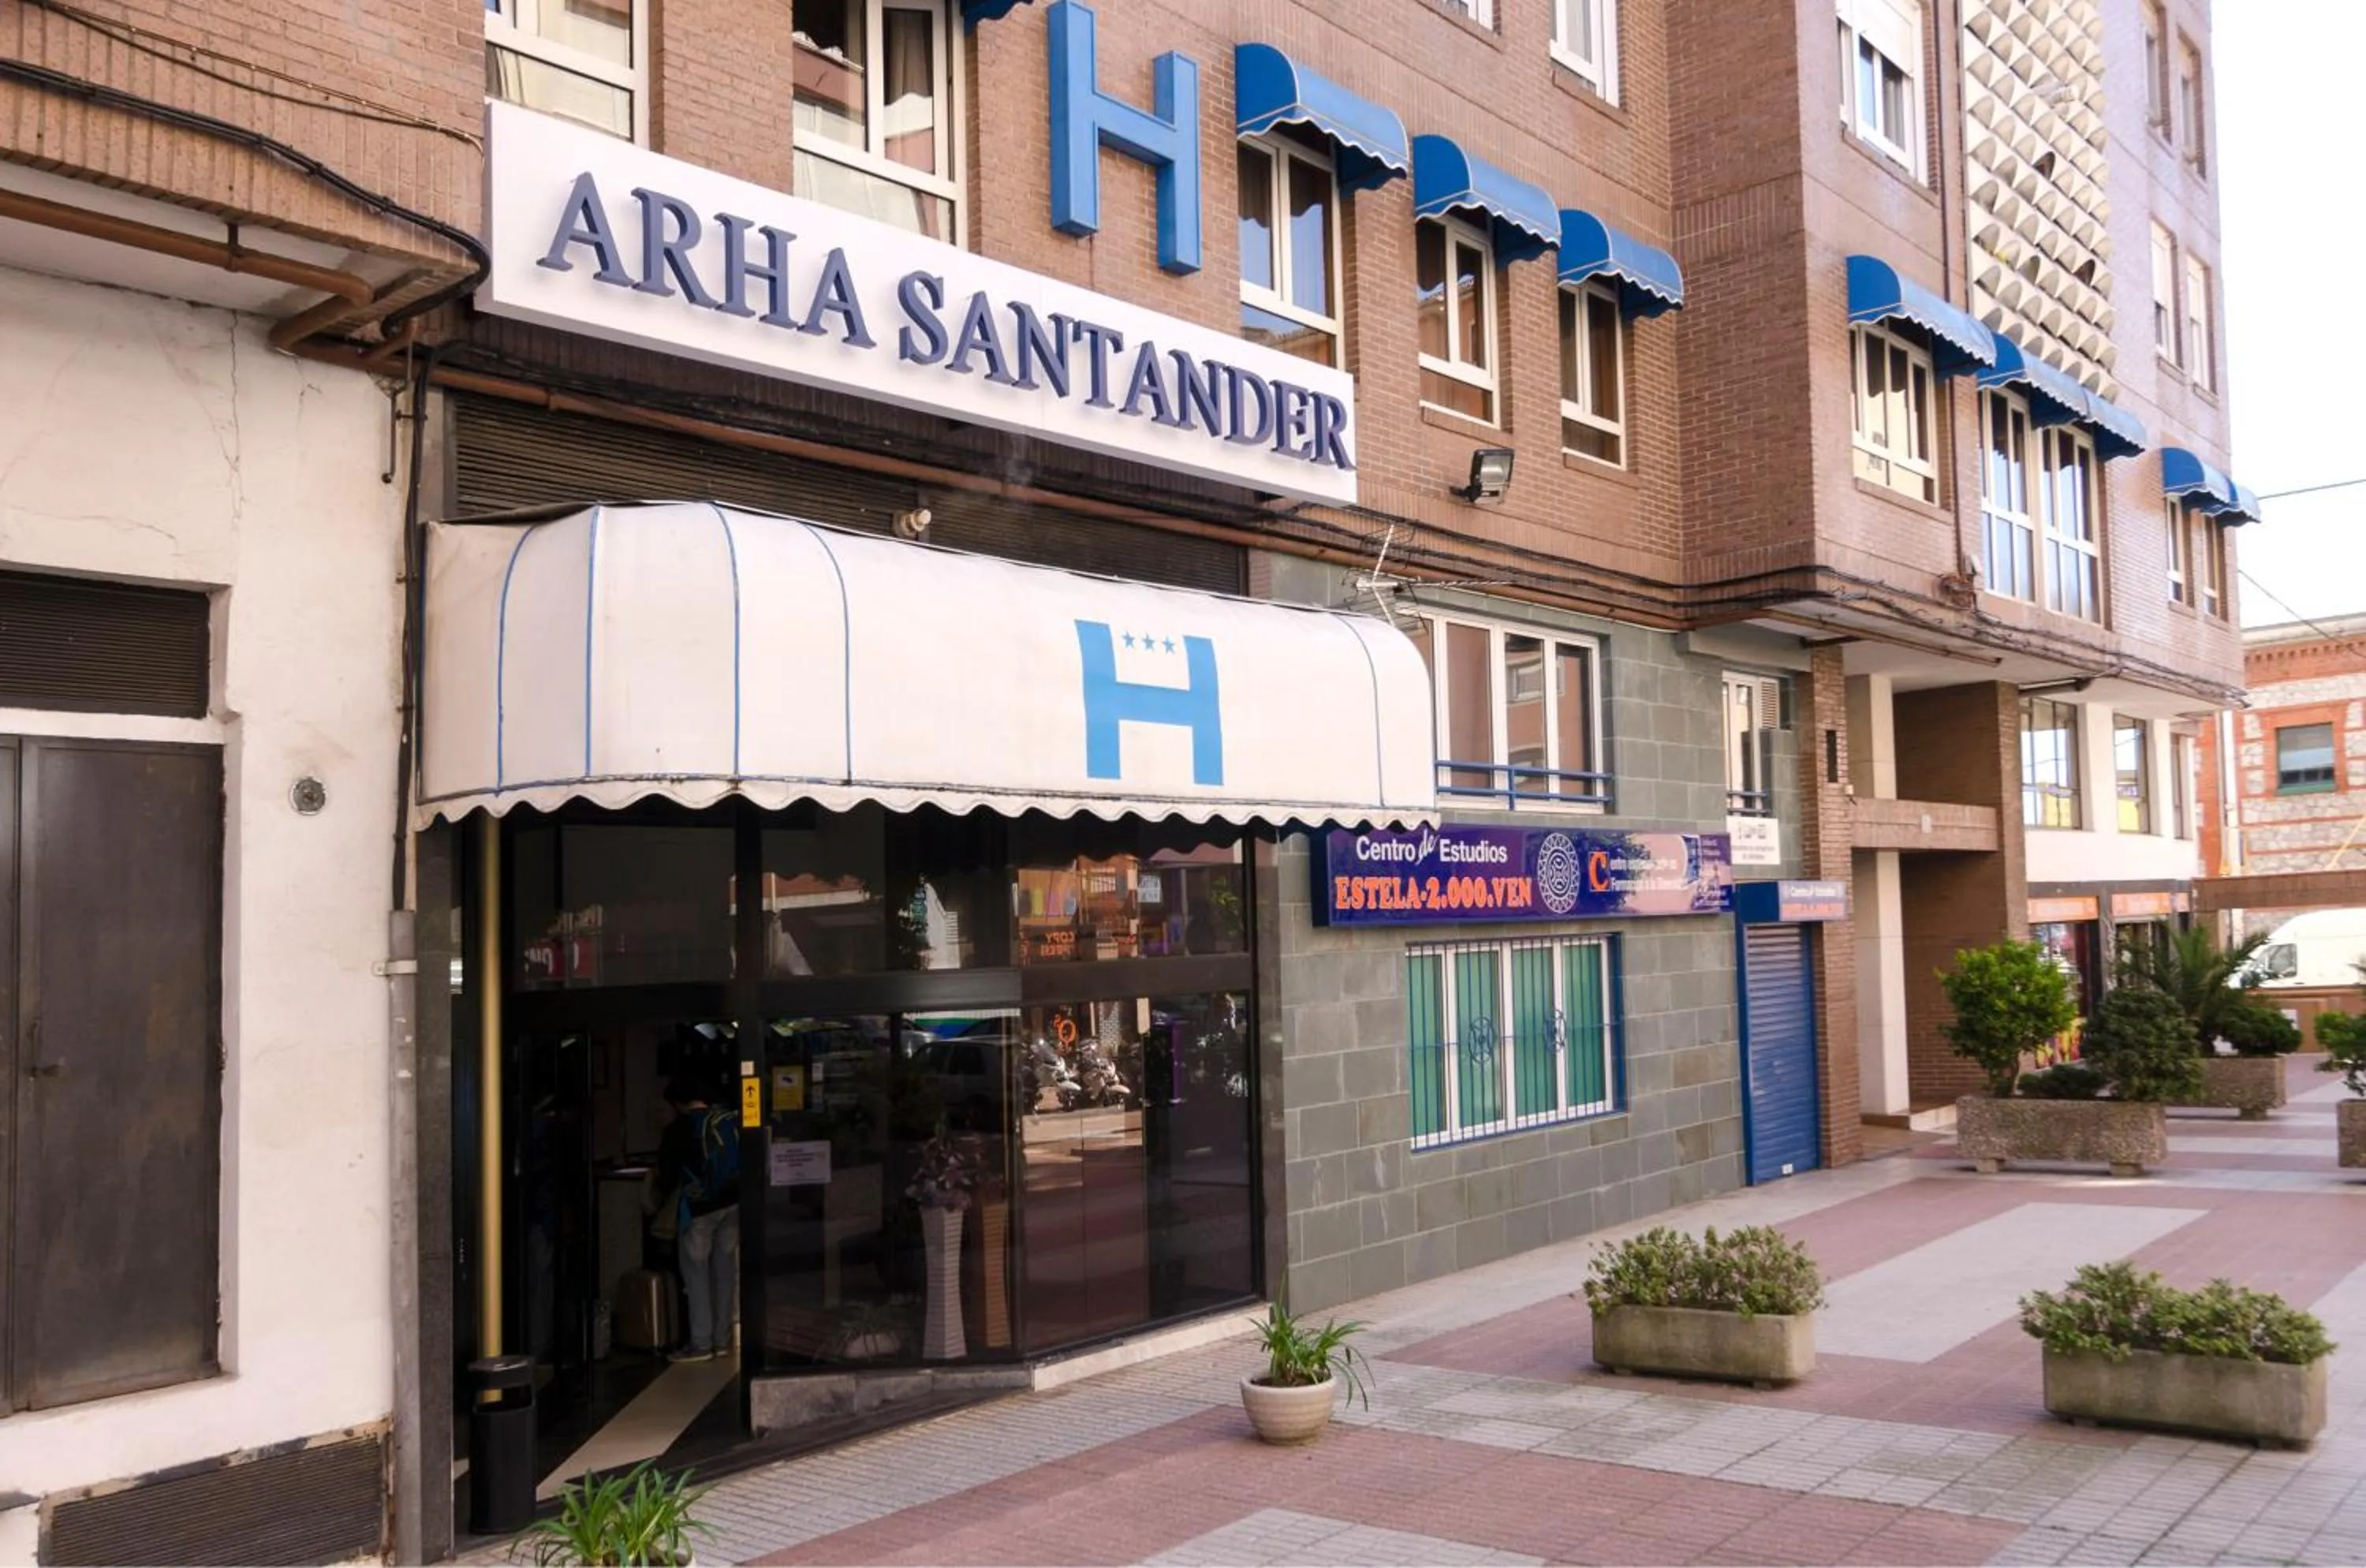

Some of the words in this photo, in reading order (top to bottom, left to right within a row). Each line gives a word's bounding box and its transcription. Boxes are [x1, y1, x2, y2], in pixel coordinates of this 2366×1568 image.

[1047, 0, 1202, 275] H
[536, 171, 877, 348] ARHA
[898, 270, 1357, 471] SANTANDER
[1073, 618, 1224, 786] H
[1356, 835, 1416, 861] Centro
[1415, 829, 1439, 865] de
[1439, 838, 1508, 862] Estudios
